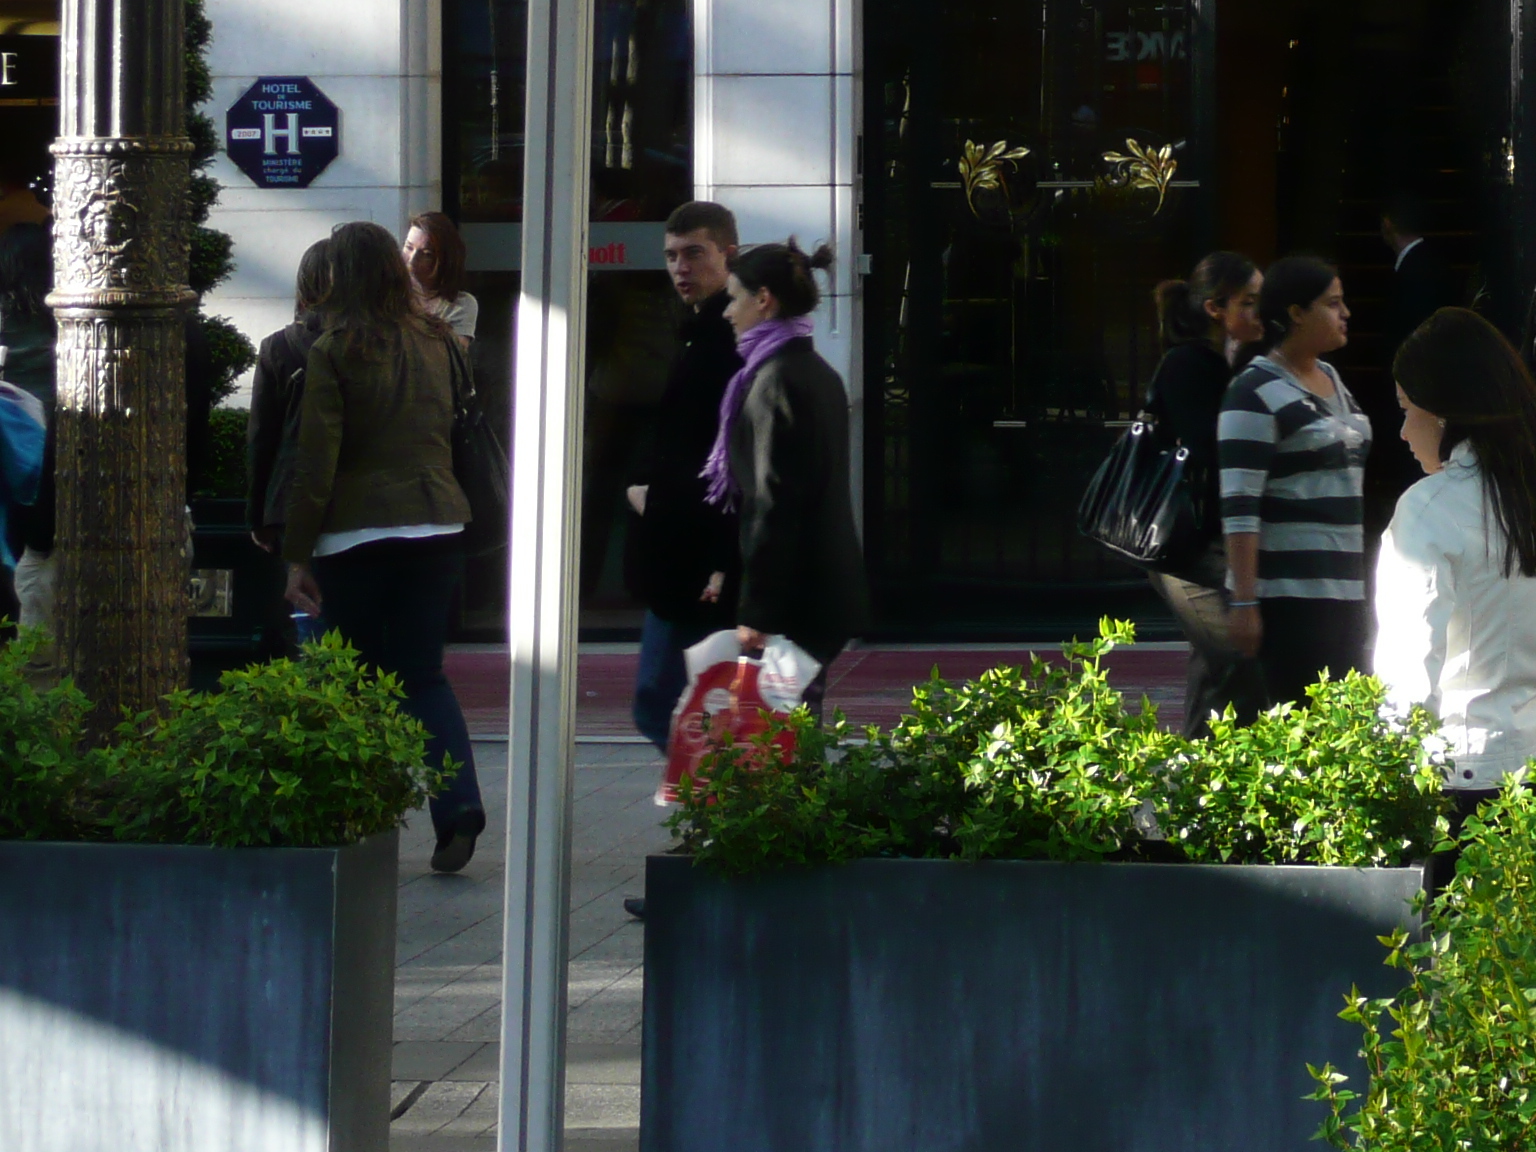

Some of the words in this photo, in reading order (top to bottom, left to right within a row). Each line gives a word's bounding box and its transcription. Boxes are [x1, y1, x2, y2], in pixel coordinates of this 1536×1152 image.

[262, 84, 302, 93] HOTEL
[251, 100, 313, 110] TOURISME
[262, 113, 302, 155] H
